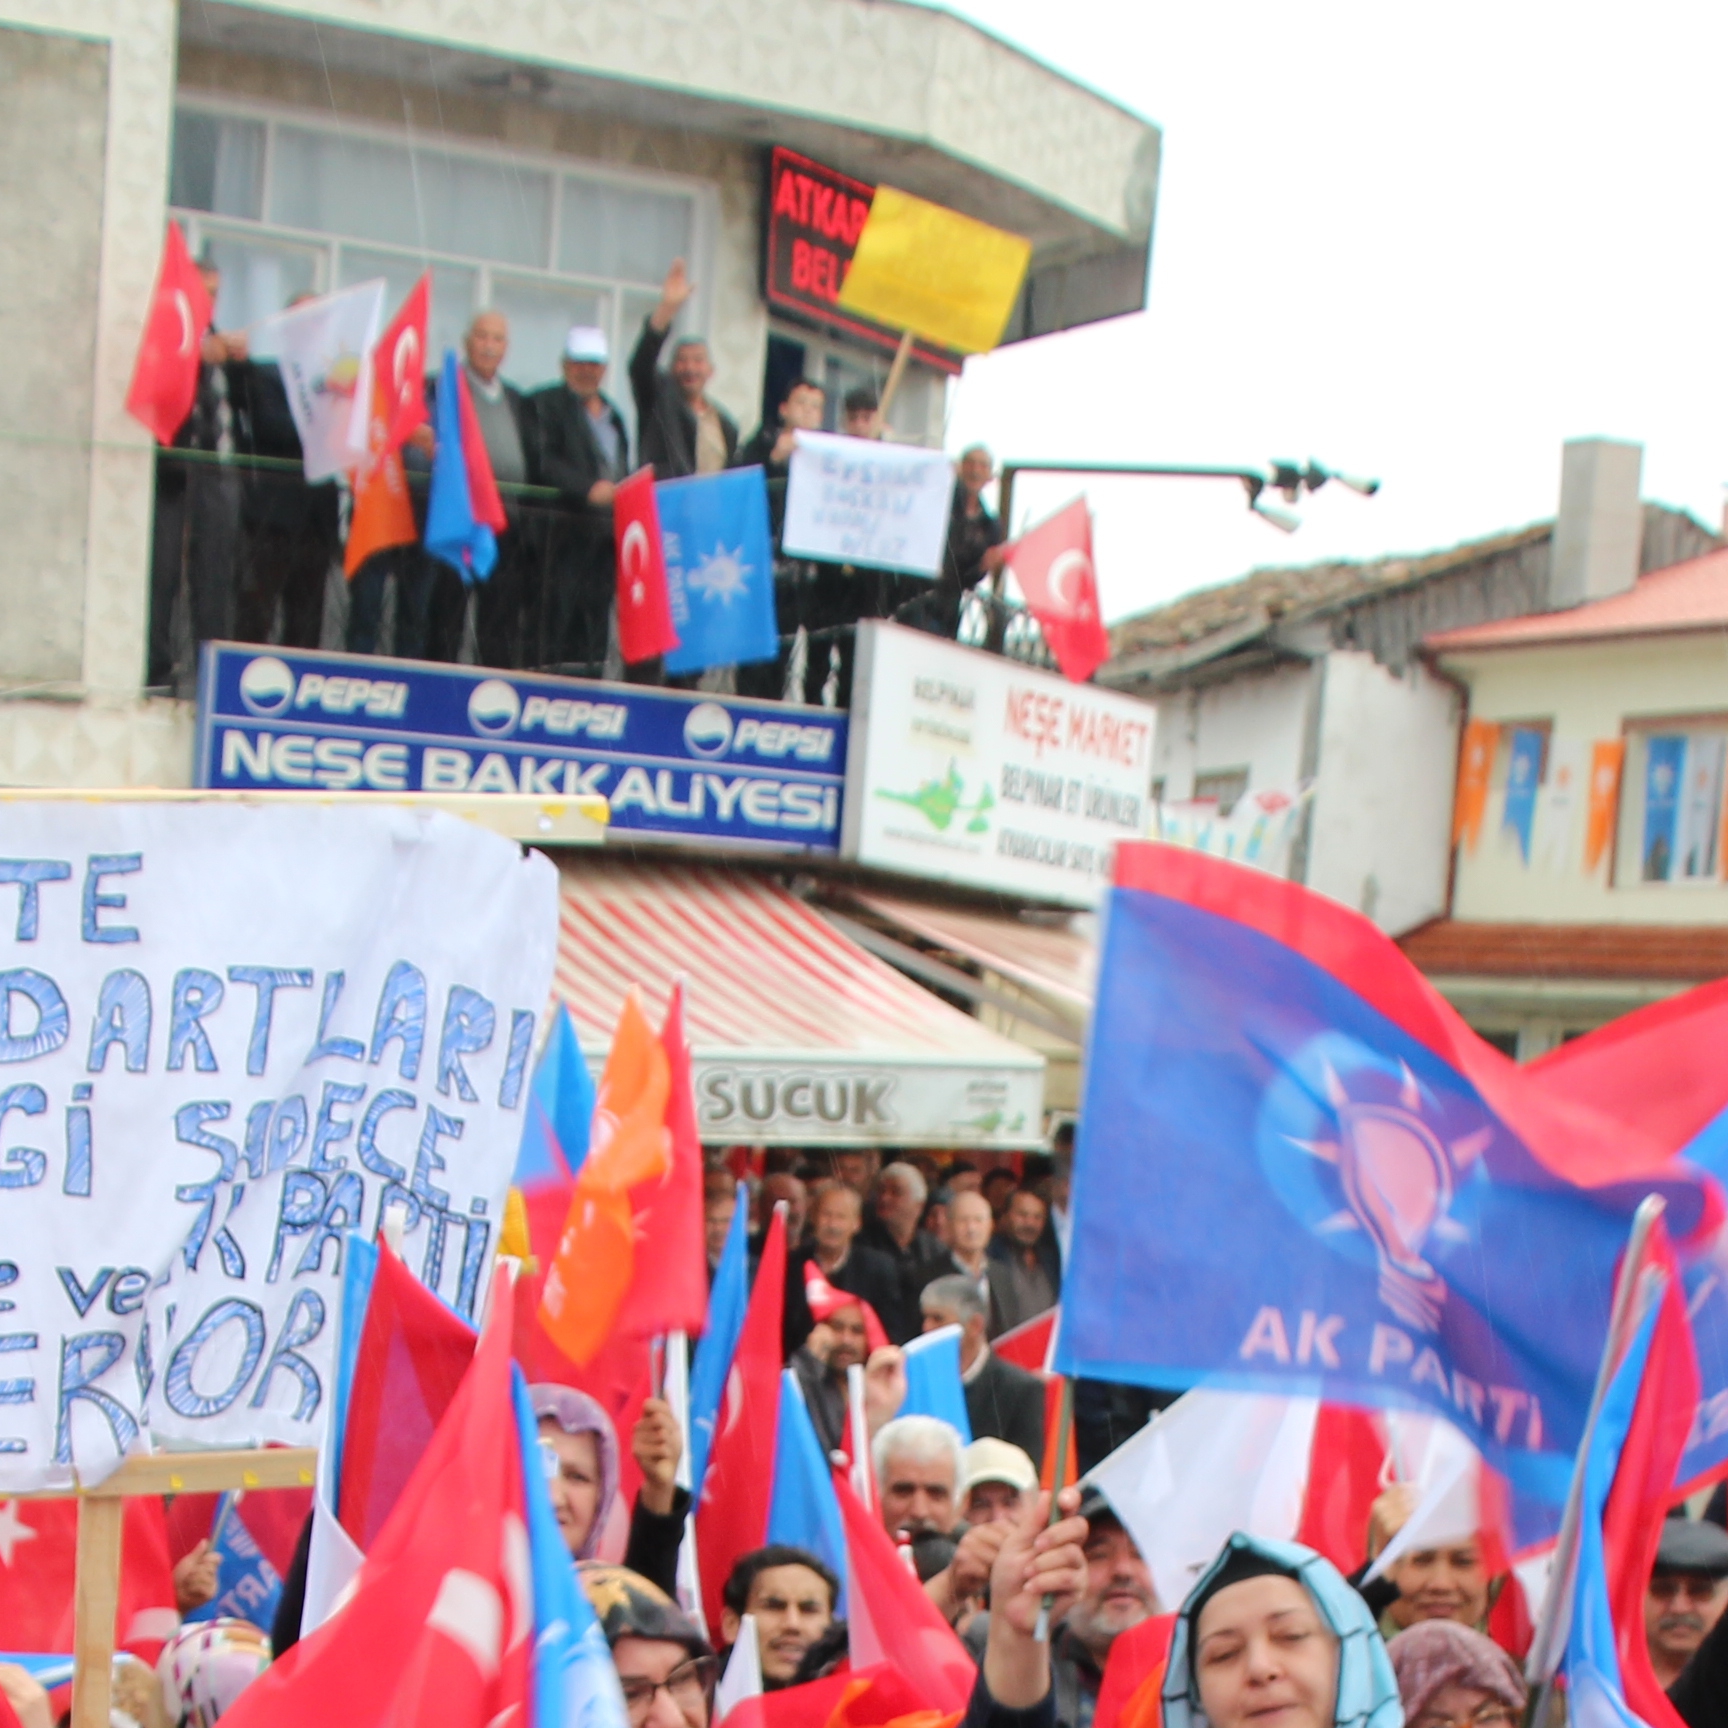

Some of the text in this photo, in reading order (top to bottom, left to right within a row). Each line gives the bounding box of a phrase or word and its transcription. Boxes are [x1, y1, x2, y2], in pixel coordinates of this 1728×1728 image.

[791, 238, 853, 304] BEL
[296, 673, 410, 718] PEPSI
[520, 697, 628, 741] PEPSI
[733, 718, 836, 762] PEPSI
[1005, 685, 1149, 767] NEŞE MARKET
[221, 728, 839, 832] NEŞE BAKKALİYESİ
[703, 1068, 893, 1126] SUCUK
[56, 1265, 152, 1319] ve
[1239, 1305, 1346, 1370] AK
